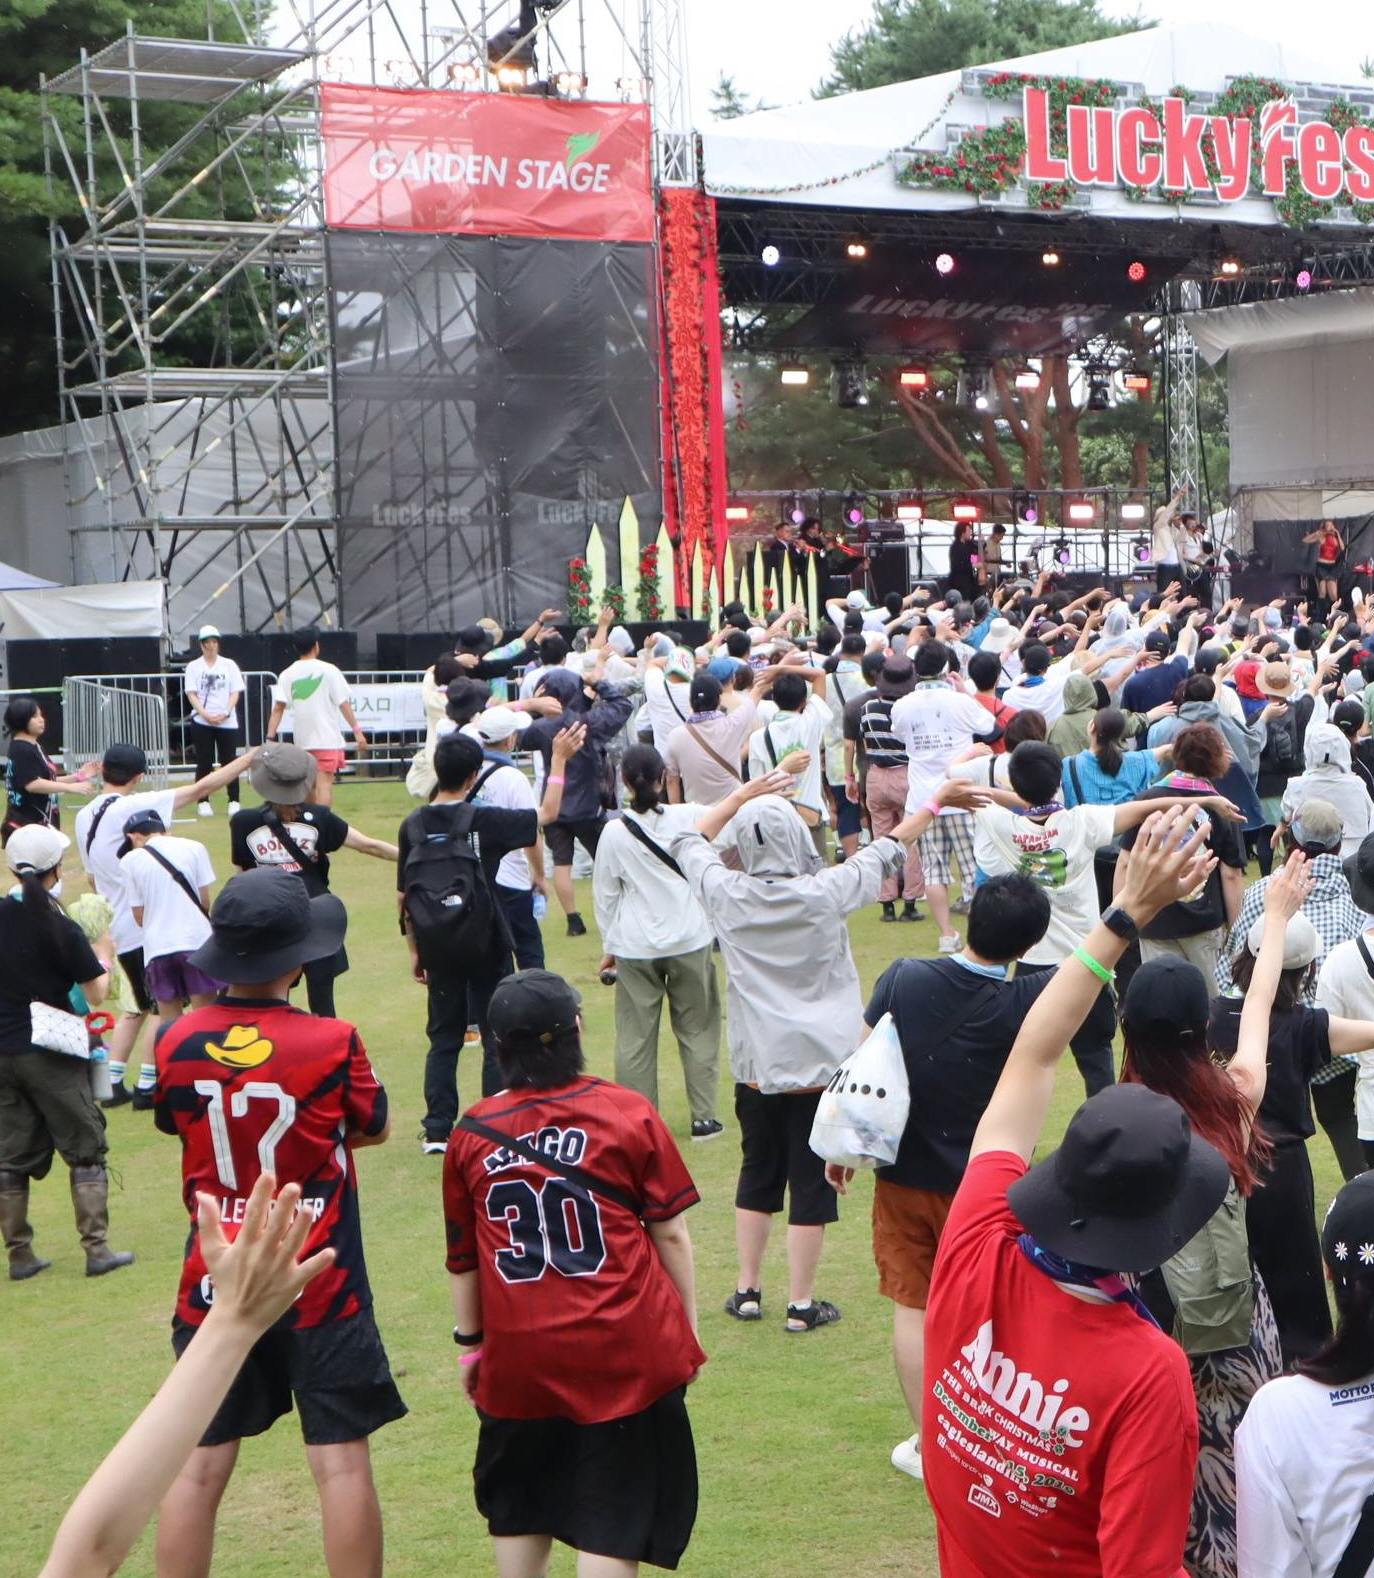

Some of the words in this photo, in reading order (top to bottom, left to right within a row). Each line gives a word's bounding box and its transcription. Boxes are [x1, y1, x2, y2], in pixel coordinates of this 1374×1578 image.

[369, 150, 507, 187] GARDEN
[516, 159, 610, 193] STAGE
[256, 838, 309, 856] BOZ
[1021, 841, 1051, 852] 2025
[485, 1177, 607, 1284] 30
[933, 1379, 993, 1443] December
[952, 1360, 961, 1372] A
[961, 1366, 978, 1390] NEW
[994, 1412, 1052, 1453] CHRISTMAS
[961, 1319, 1090, 1448] Annie
[942, 1369, 963, 1395] THE
[1016, 1447, 1080, 1482] MUSICAL
[973, 1492, 997, 1510] JMX
